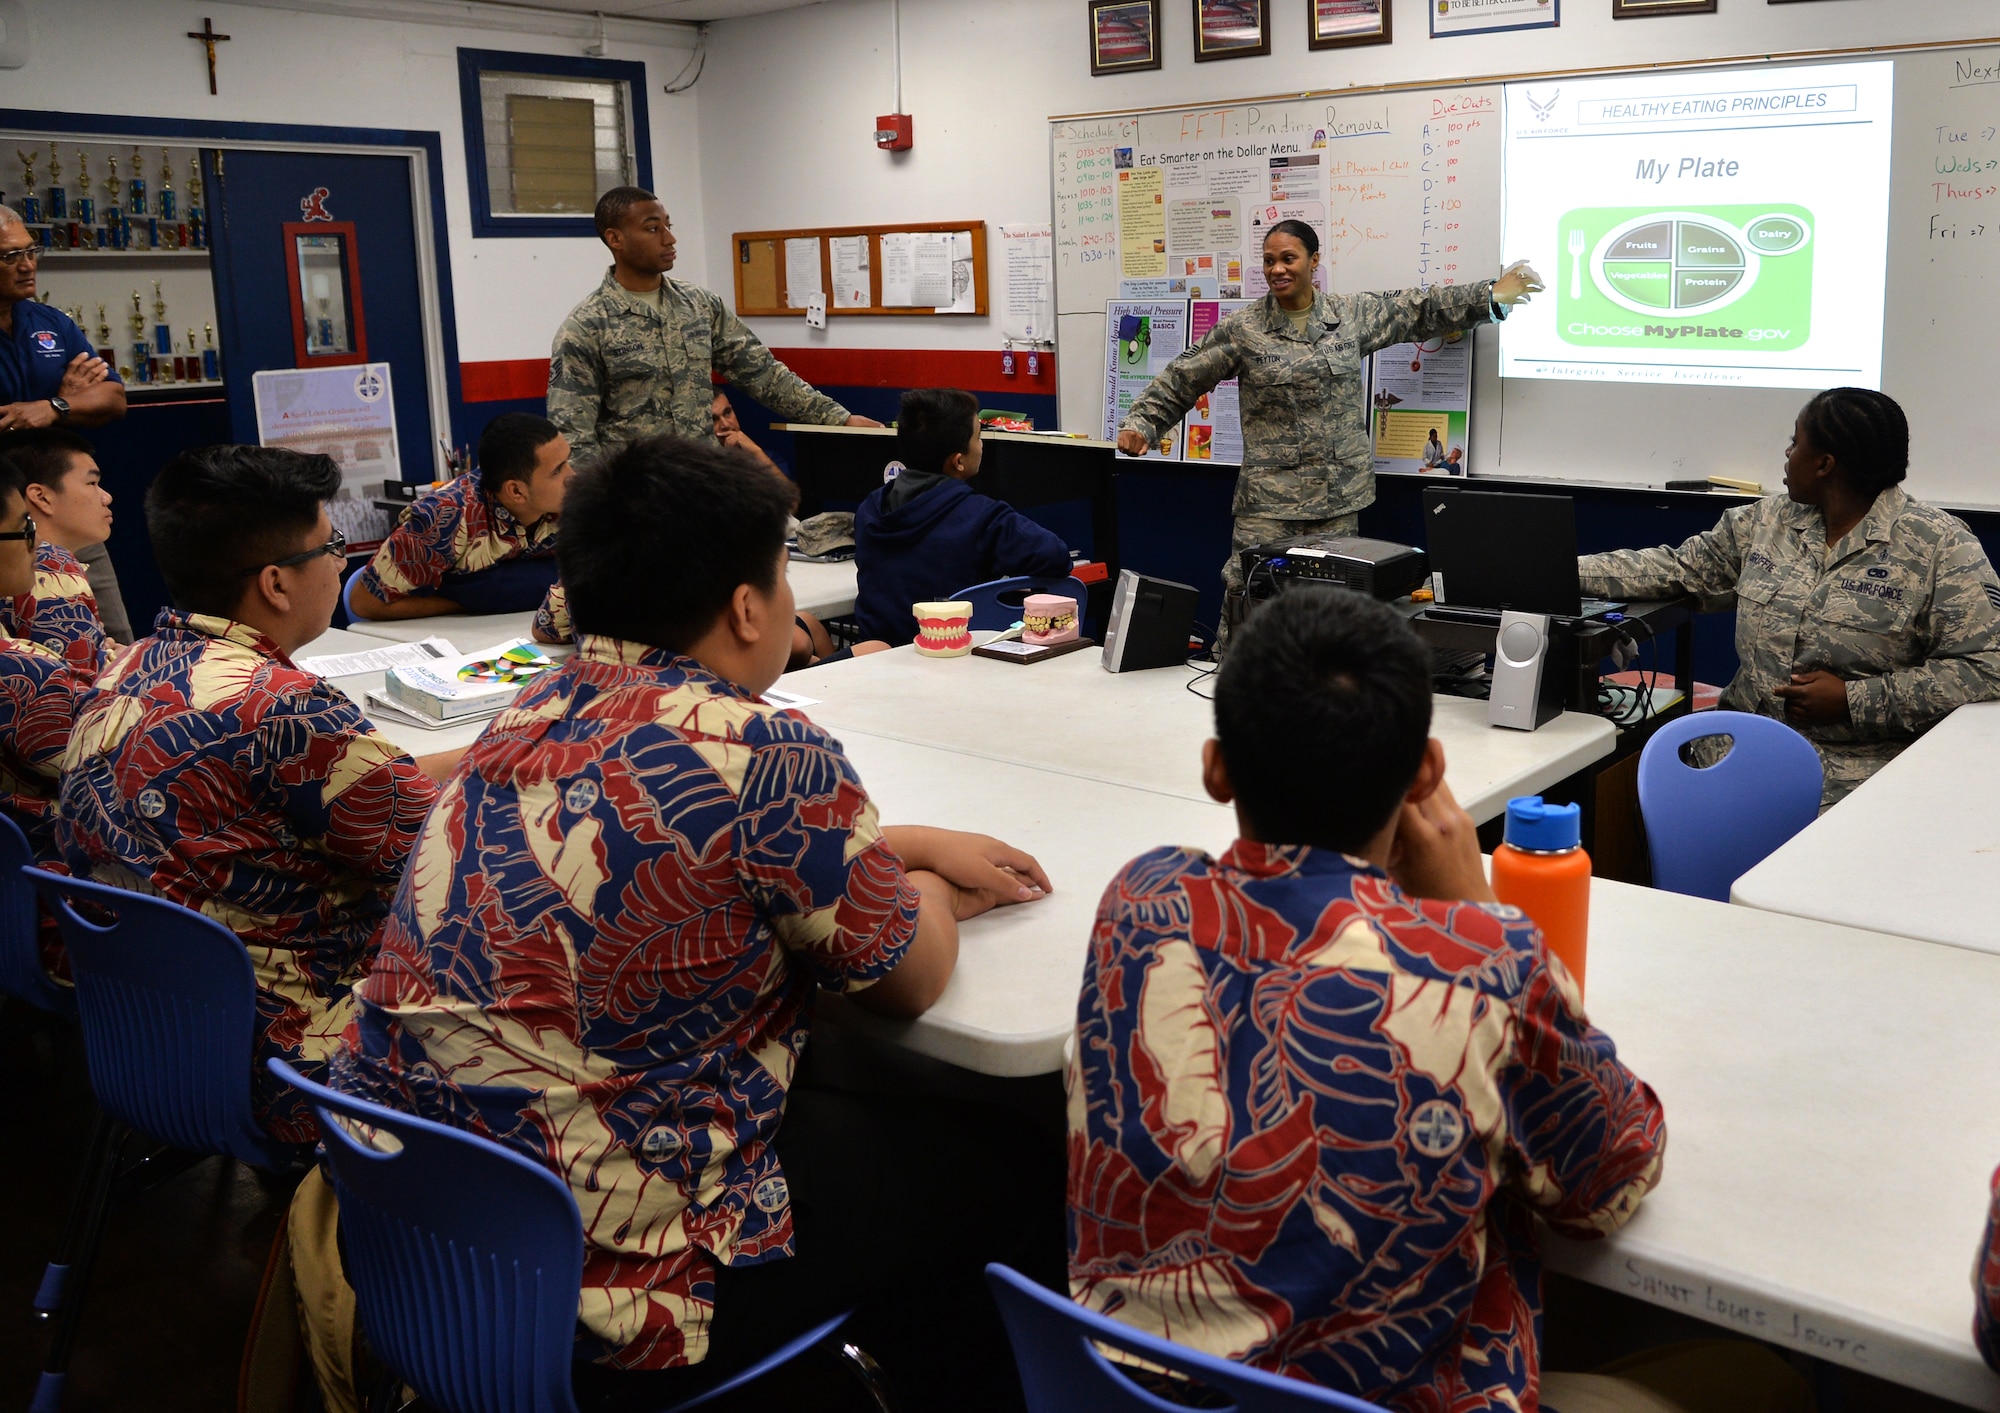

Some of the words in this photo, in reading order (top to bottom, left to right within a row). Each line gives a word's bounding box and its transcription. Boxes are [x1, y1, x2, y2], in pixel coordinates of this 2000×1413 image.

[1432, 99, 1457, 115] Due
[1462, 96, 1492, 109] Outs
[1602, 102, 1670, 118] HEALTHY
[1672, 99, 1727, 115] EATING
[1731, 93, 1827, 111] PRINCIPLES
[1326, 105, 1390, 135] Removal
[1423, 124, 1430, 138] A
[1447, 123, 1463, 133] 100
[1466, 119, 1481, 133] pts
[1068, 123, 1114, 140] Schedule
[1936, 125, 1968, 144] Tue
[1140, 154, 1156, 166] Eat
[1160, 152, 1200, 164] Smarter
[1203, 152, 1215, 160] on
[1217, 147, 1233, 160] the
[1237, 144, 1267, 158] Dollar
[1271, 142, 1301, 154] Menu.
[1423, 143, 1433, 156] B
[1447, 138, 1460, 148] 100
[1060, 162, 1067, 173] 3
[1347, 161, 1385, 176] Physical
[1421, 161, 1431, 172] C
[1447, 158, 1458, 167] 100
[1635, 157, 1670, 184] My
[1678, 157, 1739, 180] Plate
[1935, 155, 1982, 174] Weds
[1424, 179, 1432, 192] D
[1447, 175, 1456, 183] 100
[1932, 182, 1982, 203] Thurs
[1061, 204, 1066, 214] 5
[1423, 197, 1430, 214] E
[1441, 199, 1461, 210] 100
[1422, 220, 1431, 236] F
[1444, 222, 1458, 232] 100
[1759, 230, 1791, 239] Dairy
[1929, 214, 1956, 240] Fri
[1420, 242, 1430, 255] I
[1444, 244, 1458, 252] 100
[1626, 241, 1658, 250] Fruits
[1687, 246, 1725, 254] Grains
[1062, 253, 1069, 267] 7
[1418, 260, 1430, 274] J
[1610, 272, 1669, 280] Vegetables
[1684, 278, 1727, 286] Protein
[1114, 306, 1130, 316] High
[1132, 306, 1152, 315] Blood
[1154, 306, 1182, 316] Pressure
[1111, 320, 1120, 346] About
[1567, 322, 1791, 341] ChooseMyPlate.gov
[1110, 349, 1118, 374] Know
[1256, 355, 1281, 364] PEYTON
[1551, 366, 1607, 377] Integrity
[1617, 369, 1662, 378] Service
[1674, 371, 1743, 380] Excellence
[1108, 375, 1116, 406] Should
[1107, 408, 1115, 424] You
[1750, 552, 1777, 574] GRIFFIE
[1857, 582, 1872, 596] AIR
[1872, 585, 1903, 600] FORCE
